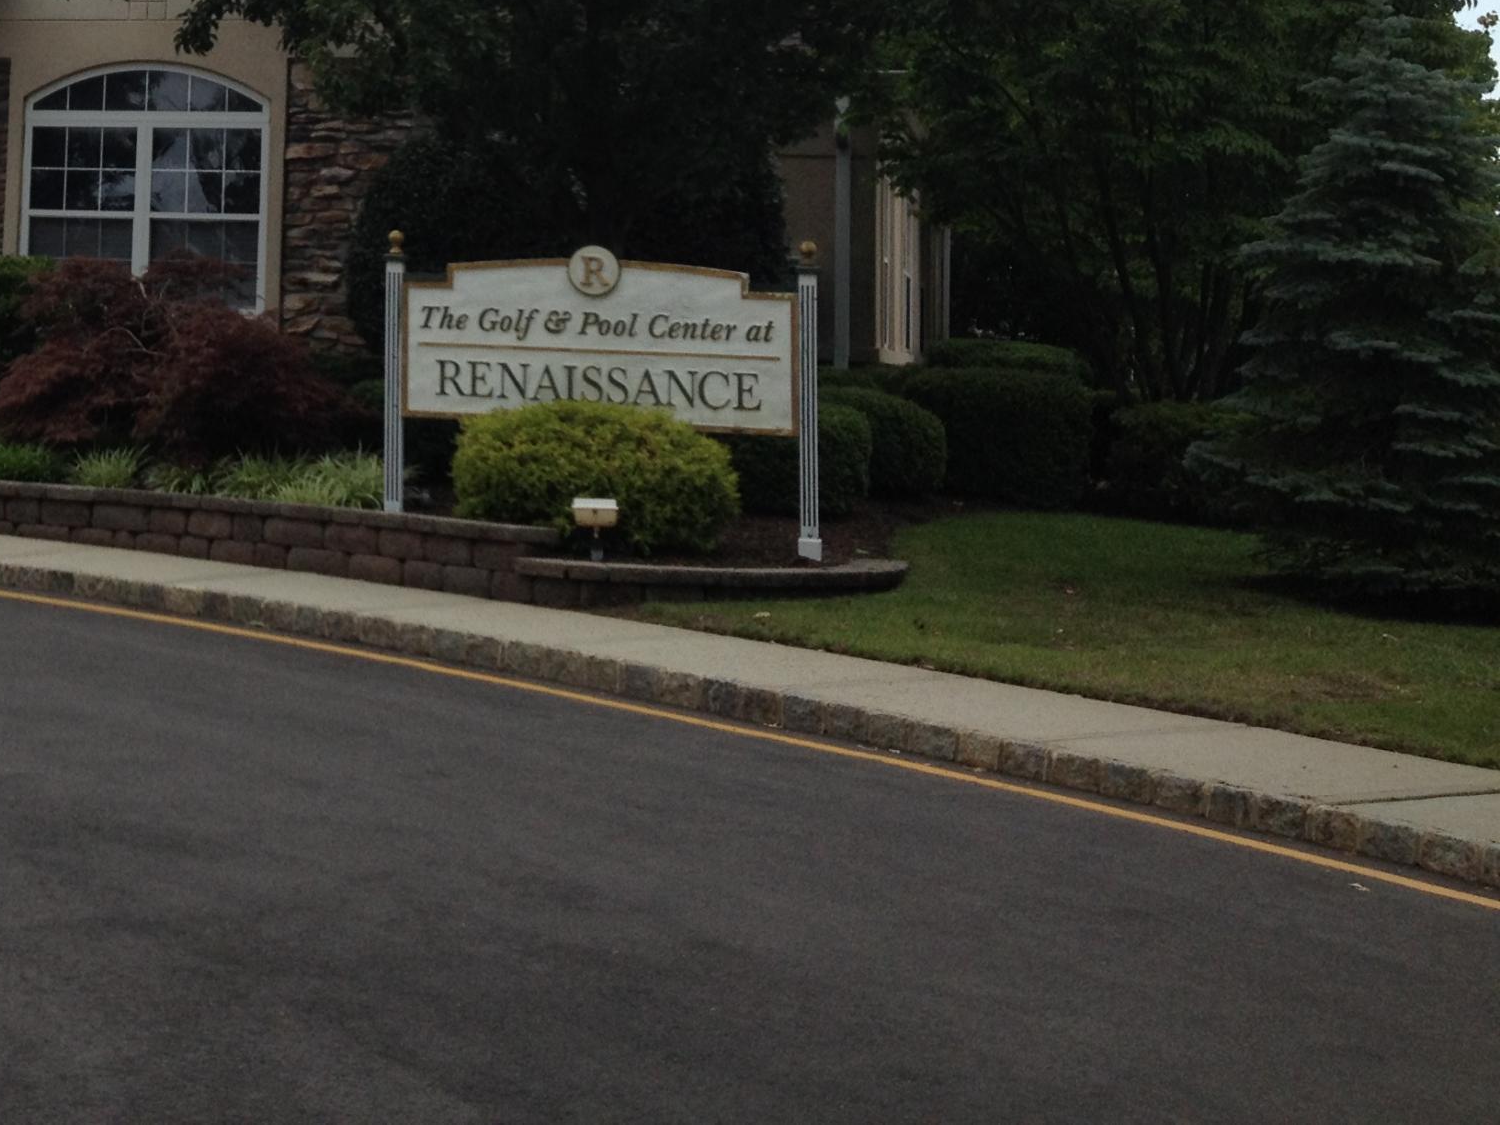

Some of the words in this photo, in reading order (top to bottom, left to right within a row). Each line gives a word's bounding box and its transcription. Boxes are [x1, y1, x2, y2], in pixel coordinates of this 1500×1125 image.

[580, 255, 610, 289] R
[420, 305, 469, 331] The
[478, 307, 539, 341] Golf
[544, 309, 572, 335] &
[578, 311, 639, 338] Pool
[648, 313, 737, 341] Center
[745, 320, 774, 343] at
[435, 358, 763, 411] RENAISSANCE
